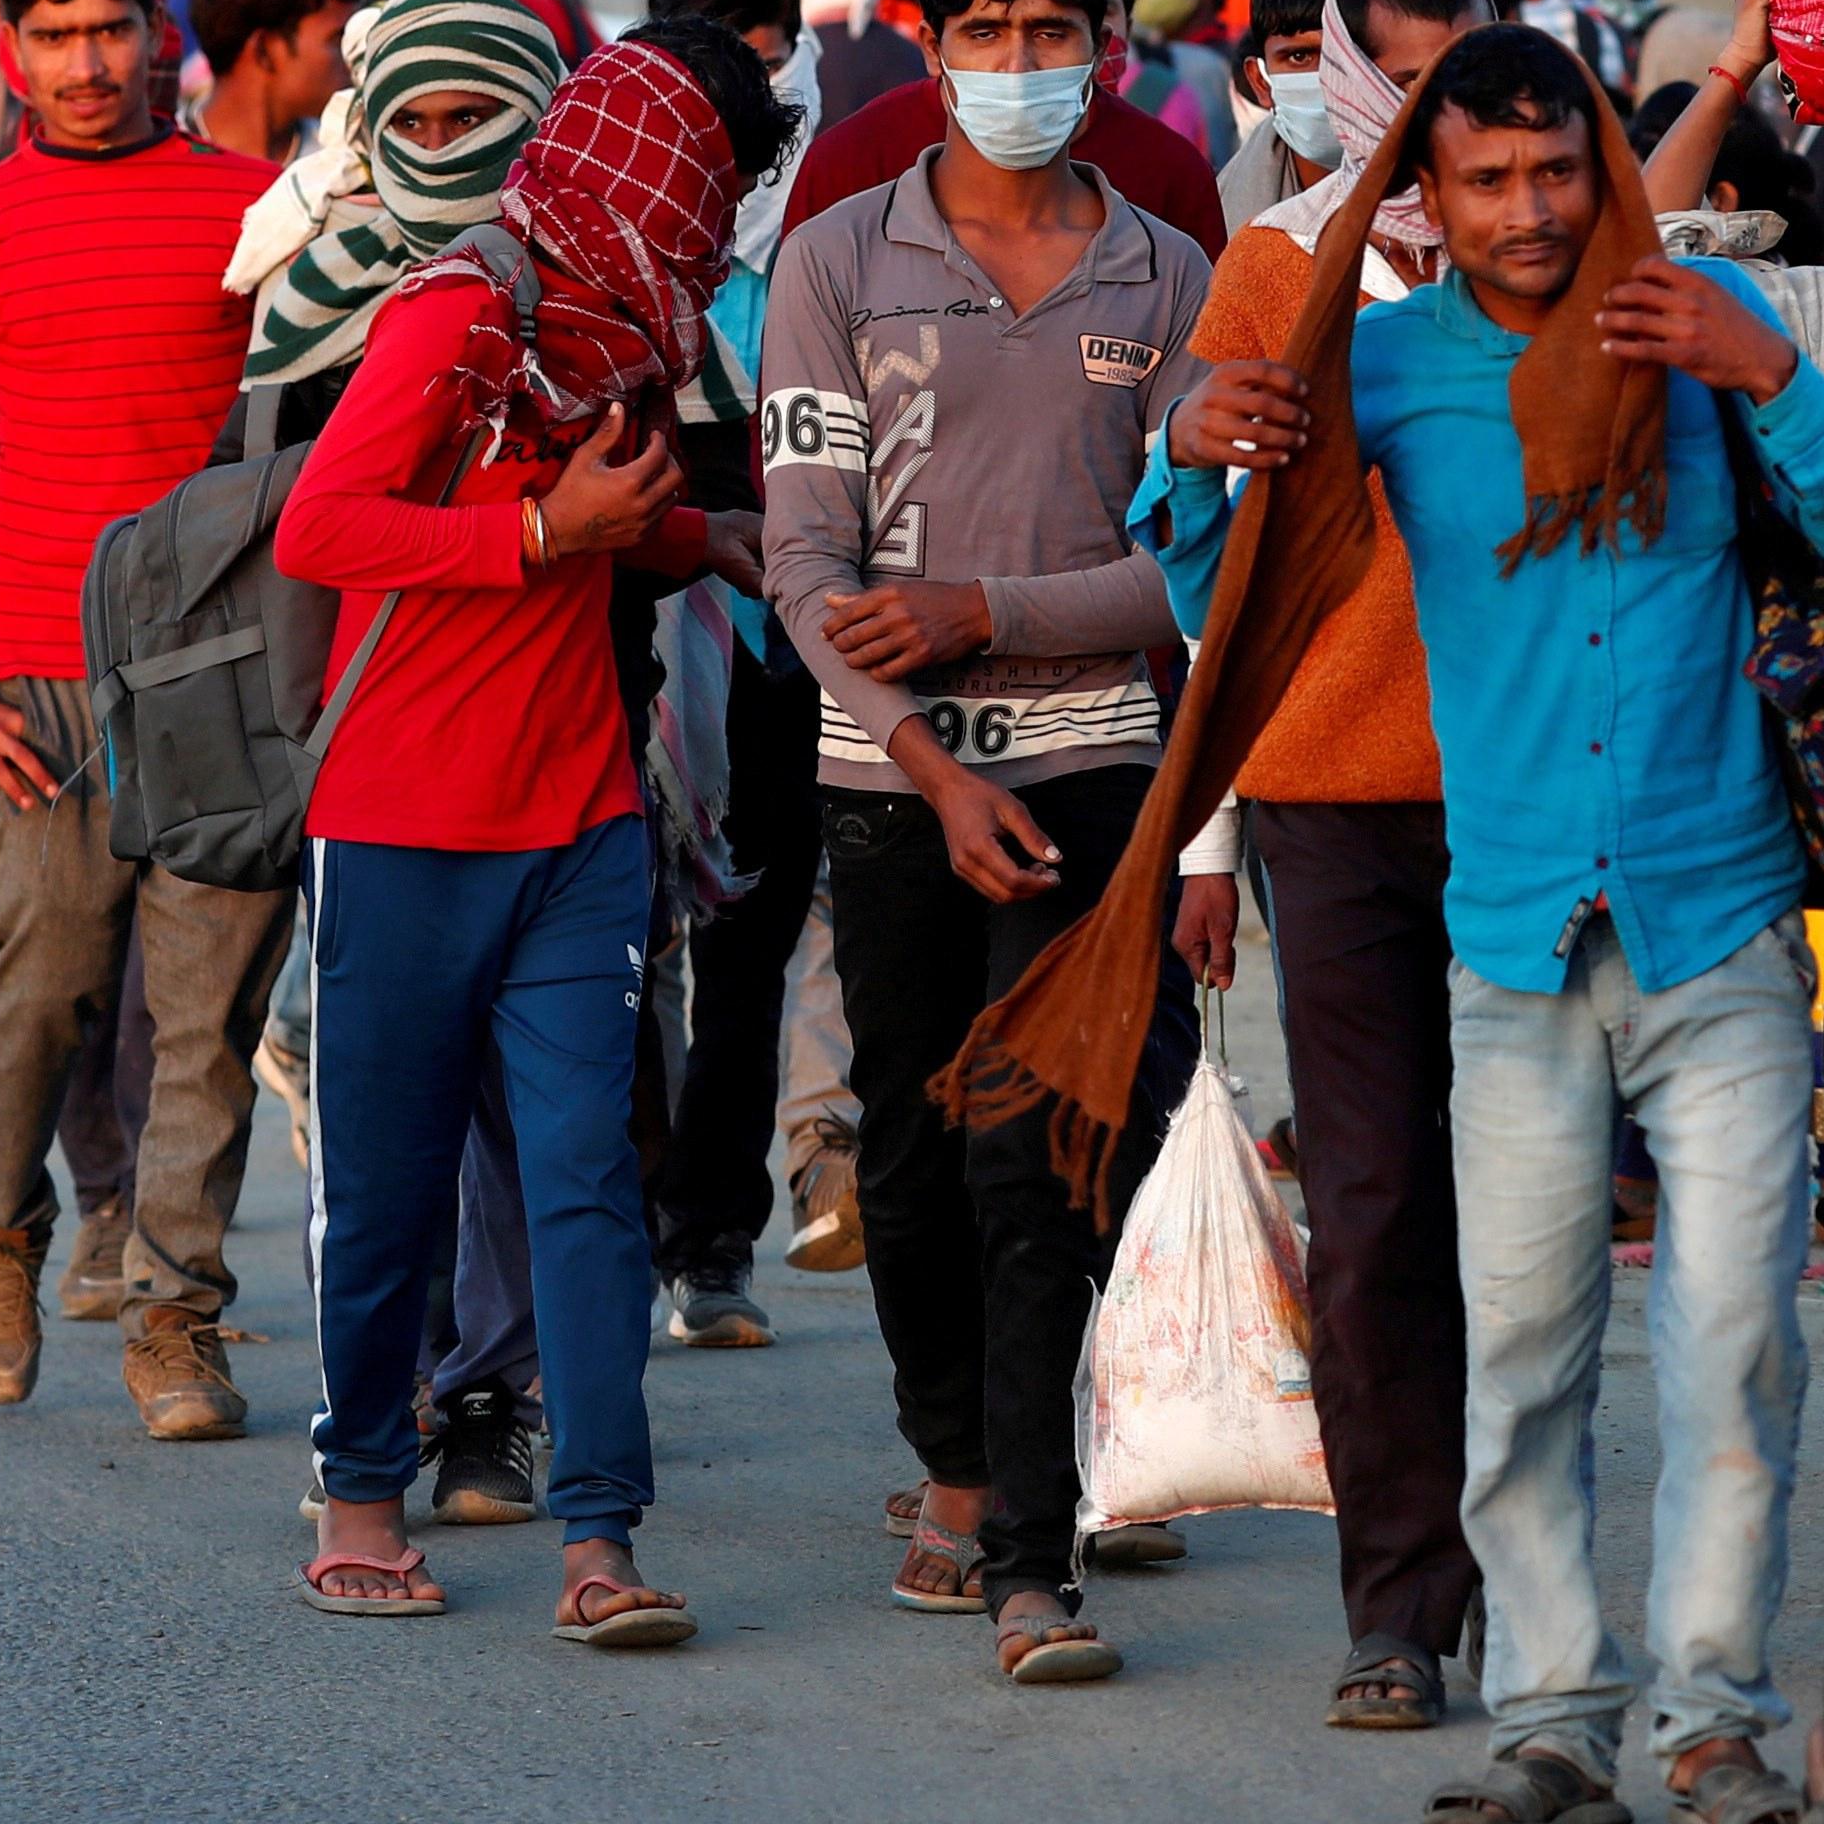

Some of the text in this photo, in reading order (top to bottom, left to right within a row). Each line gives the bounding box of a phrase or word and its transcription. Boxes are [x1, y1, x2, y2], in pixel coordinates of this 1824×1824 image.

[1086, 338, 1155, 371] DENIM
[762, 393, 826, 466] 96
[927, 700, 1017, 758] 96
